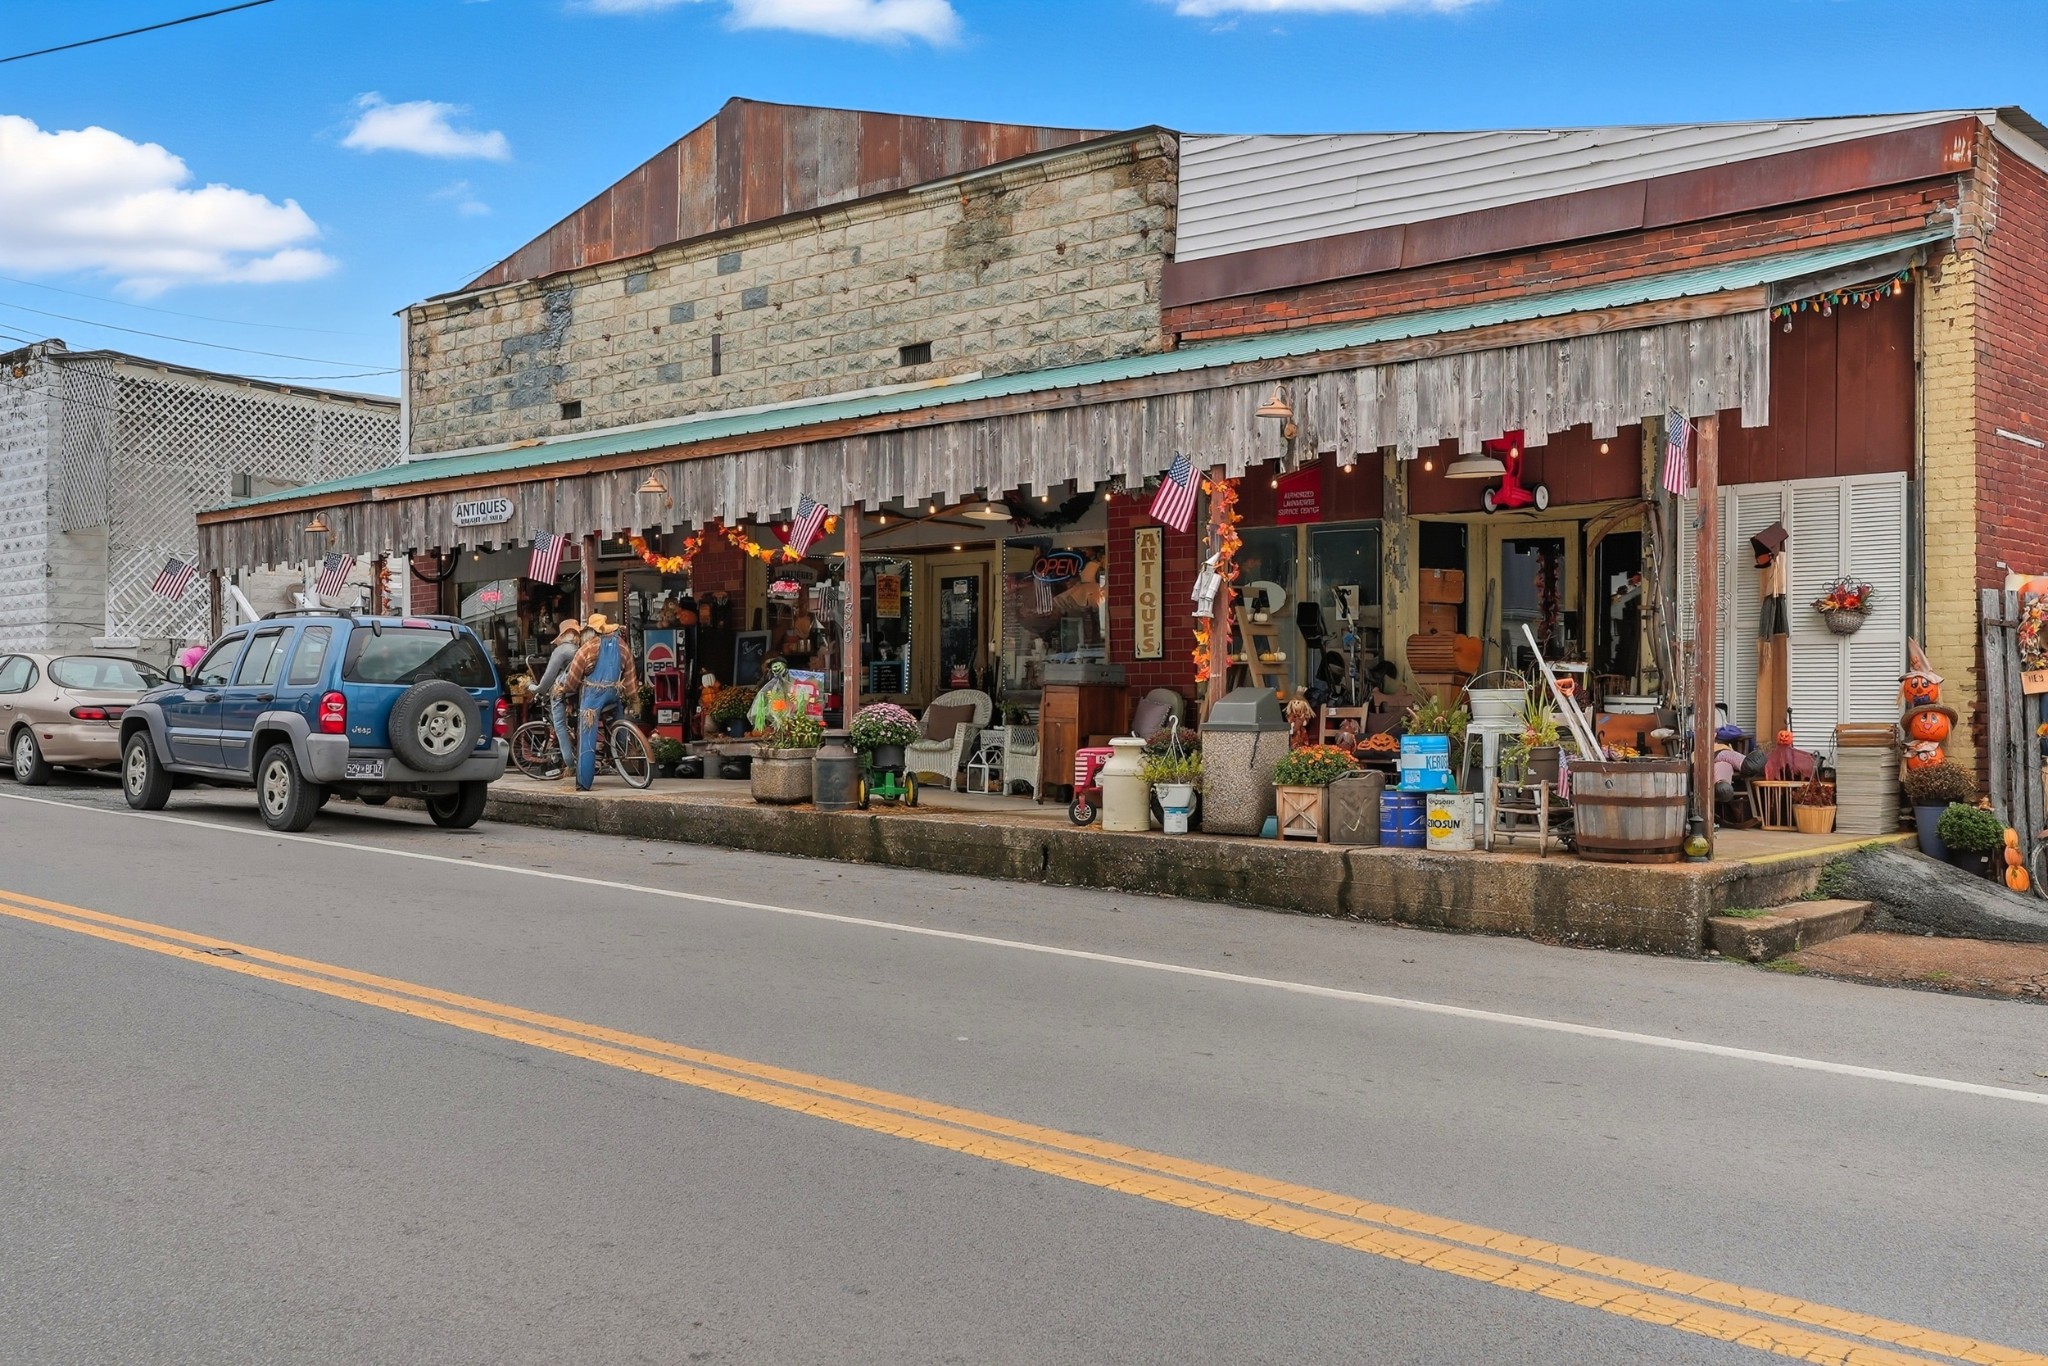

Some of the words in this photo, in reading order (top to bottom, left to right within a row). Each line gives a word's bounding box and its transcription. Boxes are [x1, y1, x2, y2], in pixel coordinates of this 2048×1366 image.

[456, 499, 507, 518] ANTIQUES
[1034, 558, 1078, 576] OPEN
[1140, 533, 1157, 653] ANTIQUES
[351, 725, 372, 735] Jeep
